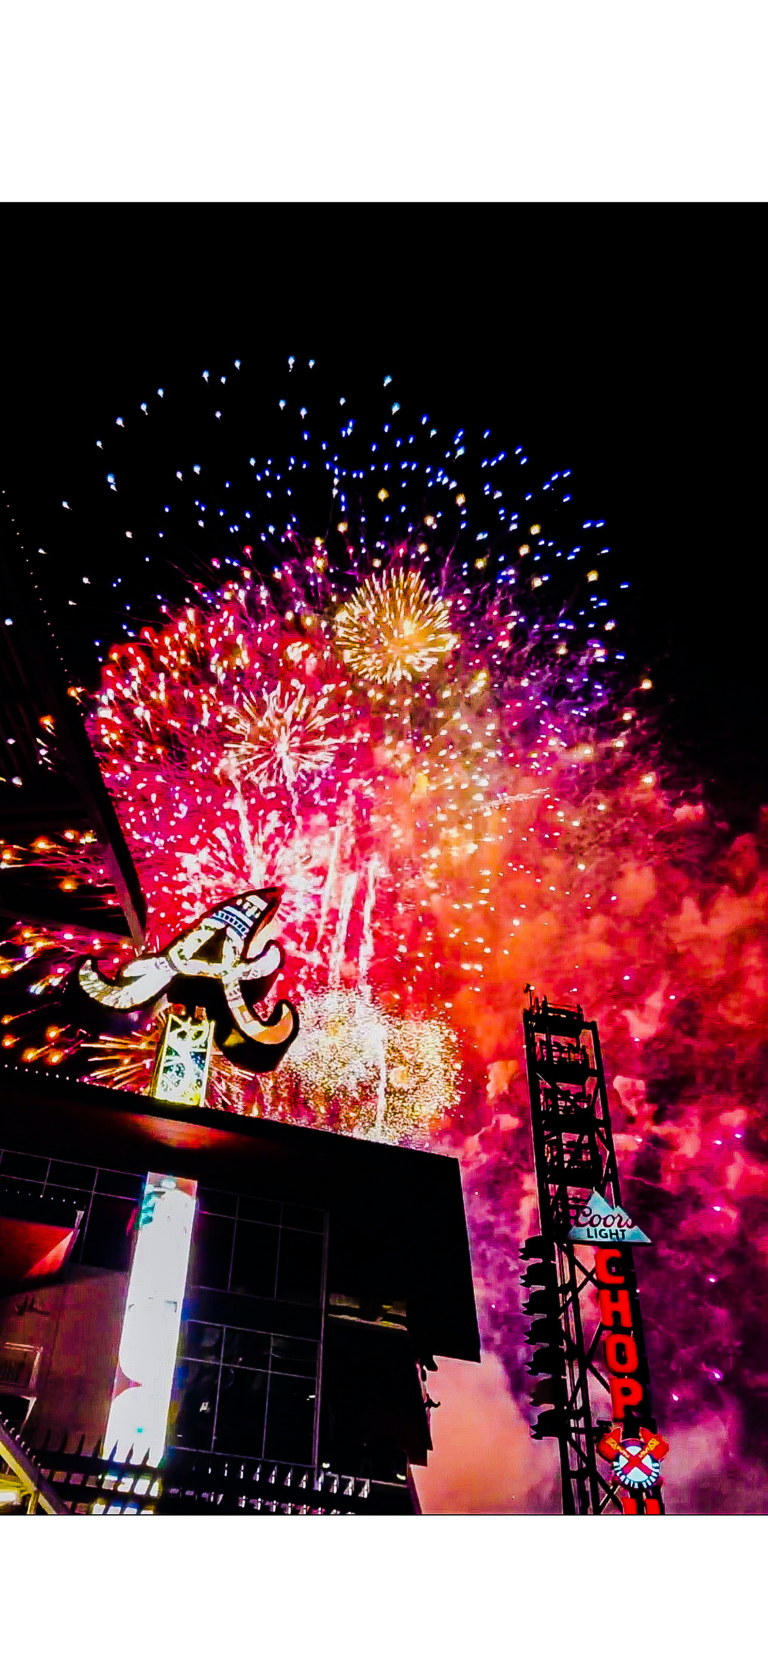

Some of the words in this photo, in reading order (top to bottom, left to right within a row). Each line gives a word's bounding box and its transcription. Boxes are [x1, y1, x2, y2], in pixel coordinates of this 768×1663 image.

[78, 888, 295, 1048] A
[575, 1206, 636, 1229] Coors
[586, 1228, 626, 1240] LIGHT
[594, 1248, 643, 1420] CHOP
